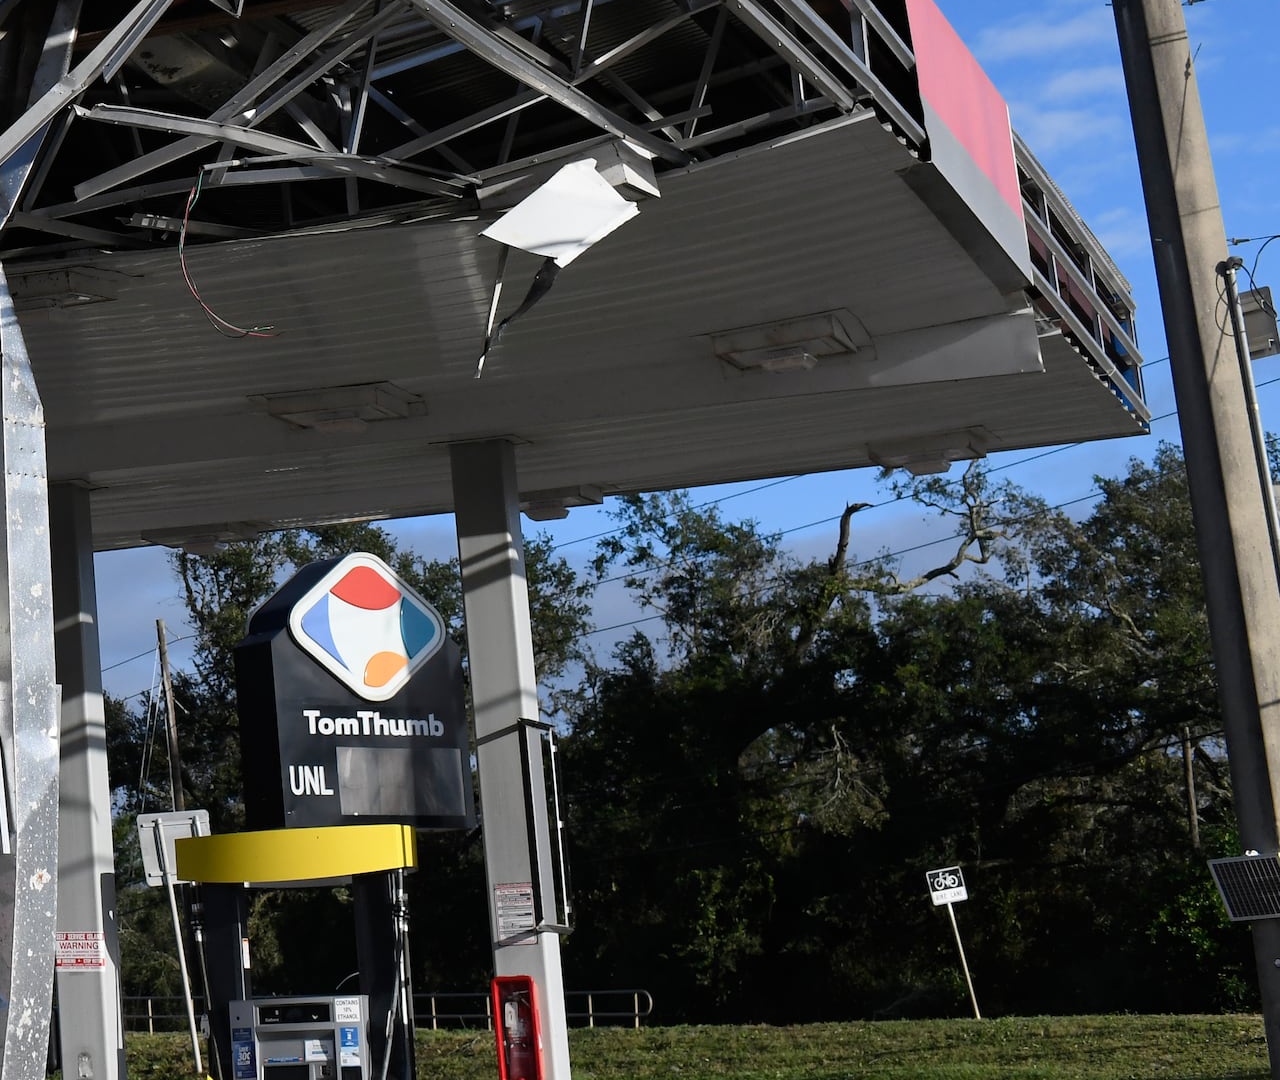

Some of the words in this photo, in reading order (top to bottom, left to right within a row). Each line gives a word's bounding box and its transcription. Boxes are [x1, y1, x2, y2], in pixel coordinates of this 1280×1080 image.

[303, 709, 444, 737] TomThumb
[289, 765, 334, 796] UNL
[59, 941, 99, 950] WARNING
